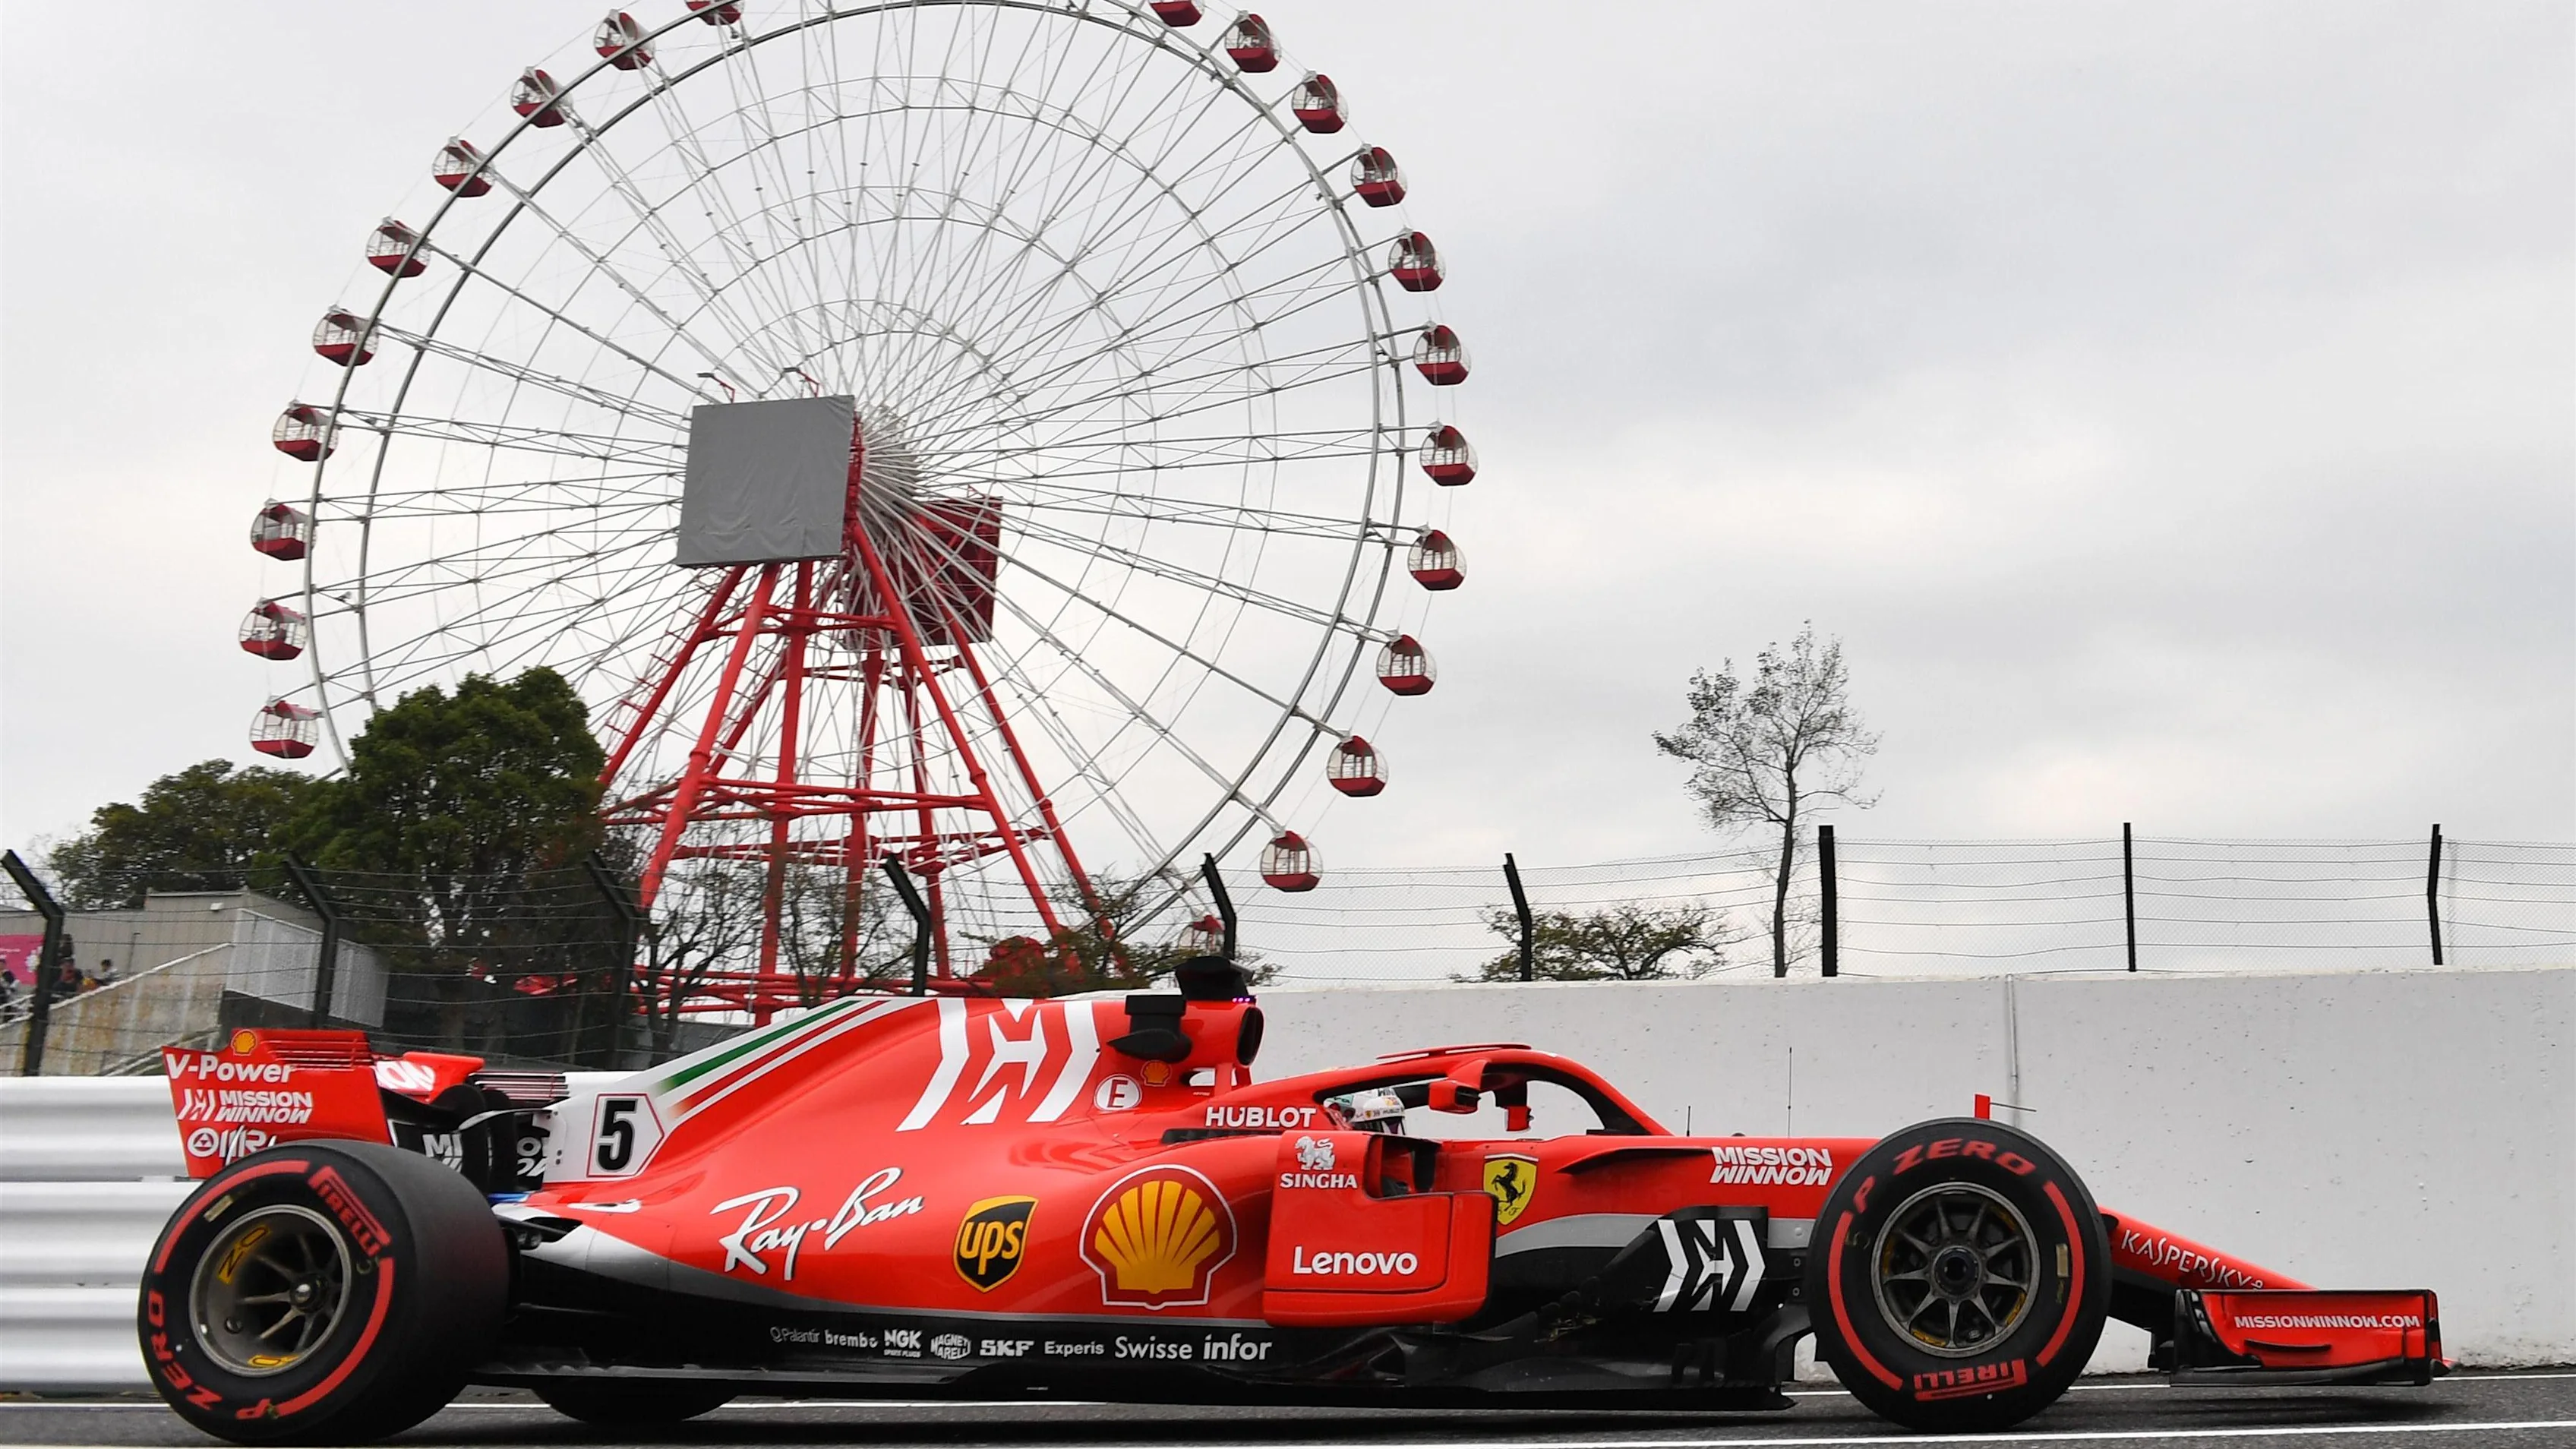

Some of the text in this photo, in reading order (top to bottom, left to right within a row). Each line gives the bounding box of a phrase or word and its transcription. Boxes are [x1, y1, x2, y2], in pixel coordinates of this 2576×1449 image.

[166, 1053, 294, 1083] V-Power
[219, 1090, 312, 1107] MISSION
[1106, 1079, 1129, 1108] E
[214, 1106, 313, 1124] WINNOW
[1205, 1106, 1316, 1128] HUBLOT
[597, 1098, 638, 1172] 5
[1712, 1147, 1830, 1167] MISSION
[1893, 1138, 2037, 1176] ZERO
[1280, 1172, 1358, 1189] SINGHA
[1709, 1166, 1833, 1185] WINNOW
[308, 1165, 392, 1256] PIRELLI
[1293, 1245, 1418, 1275] Lenovo
[2121, 1230, 2252, 1287] KASPERSKY
[2234, 1315, 2421, 1328] MISSIONWINNOW.COM
[148, 1289, 223, 1410] ZERO
[825, 1329, 878, 1348] brembo
[884, 1329, 923, 1349] NGK
[980, 1333, 1272, 1360] SKF Experis Swisse infor
[1913, 1358, 2028, 1402] PIRELLI
